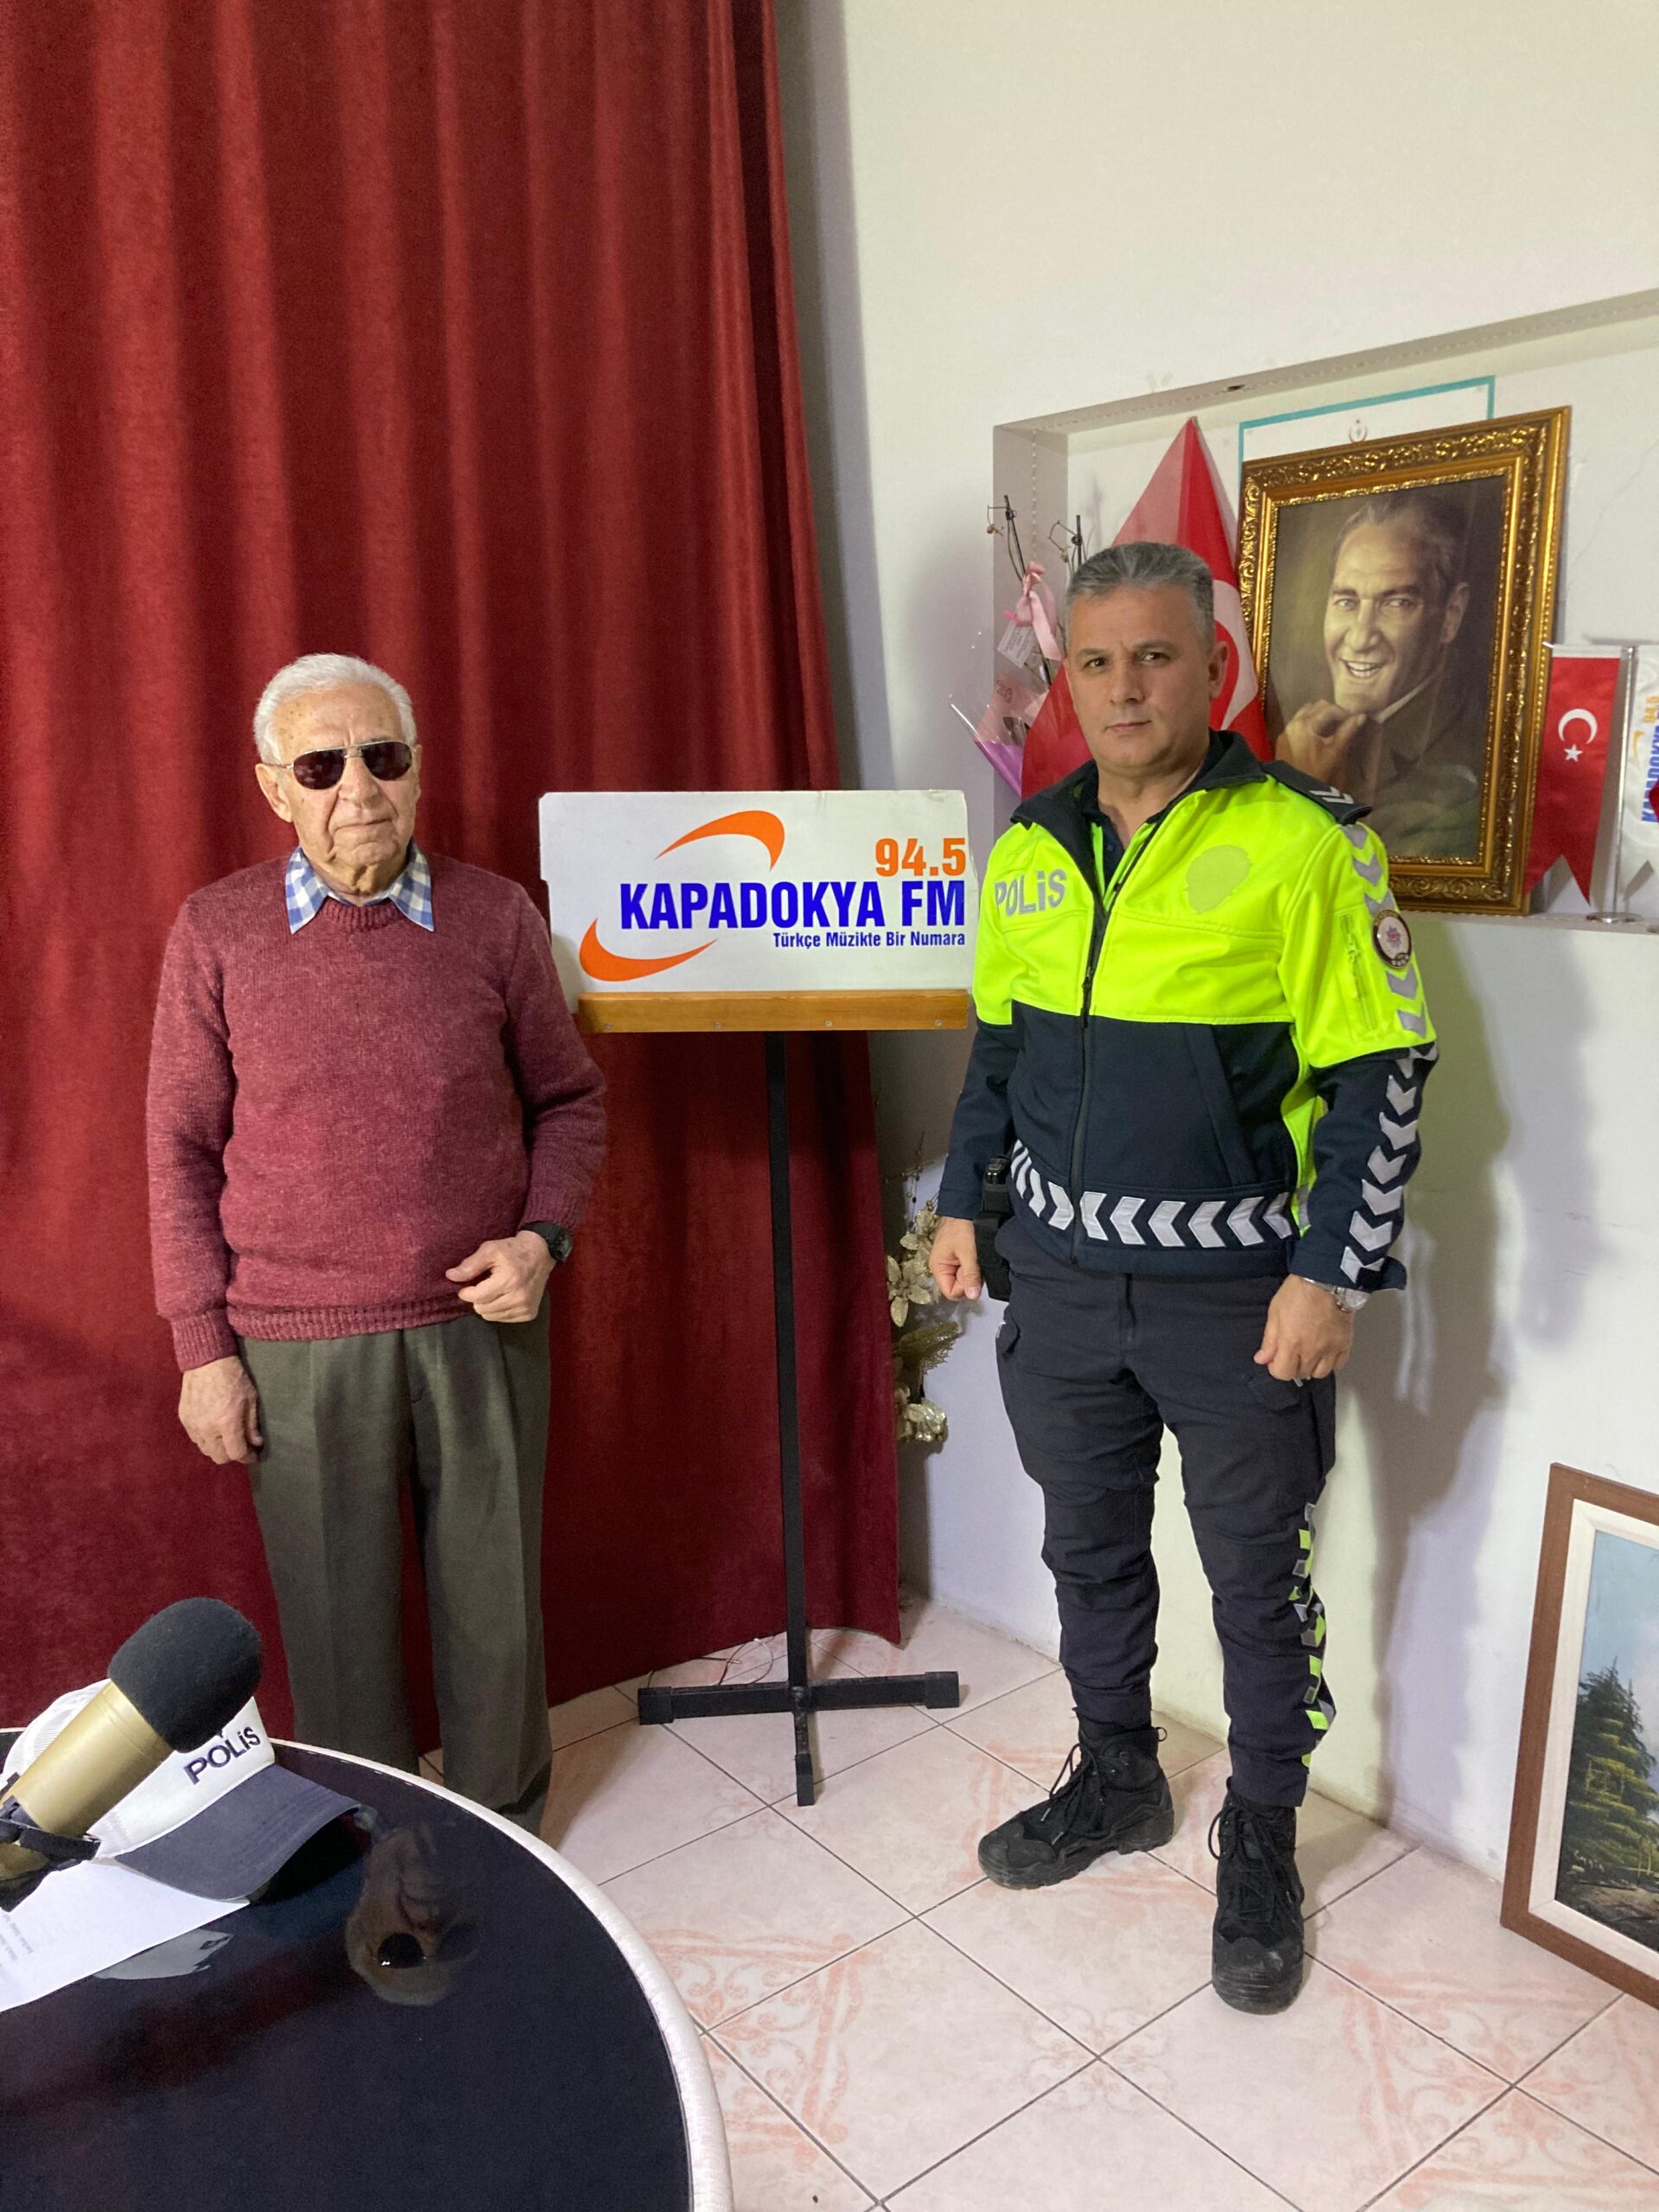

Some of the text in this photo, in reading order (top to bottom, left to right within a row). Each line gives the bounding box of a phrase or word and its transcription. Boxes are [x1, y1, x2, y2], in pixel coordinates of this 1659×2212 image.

[875, 837, 966, 877] 94.5
[620, 880, 964, 930] KAPADOKYA FM
[773, 931, 965, 950] Türkçe Müzikte Bir Numara
